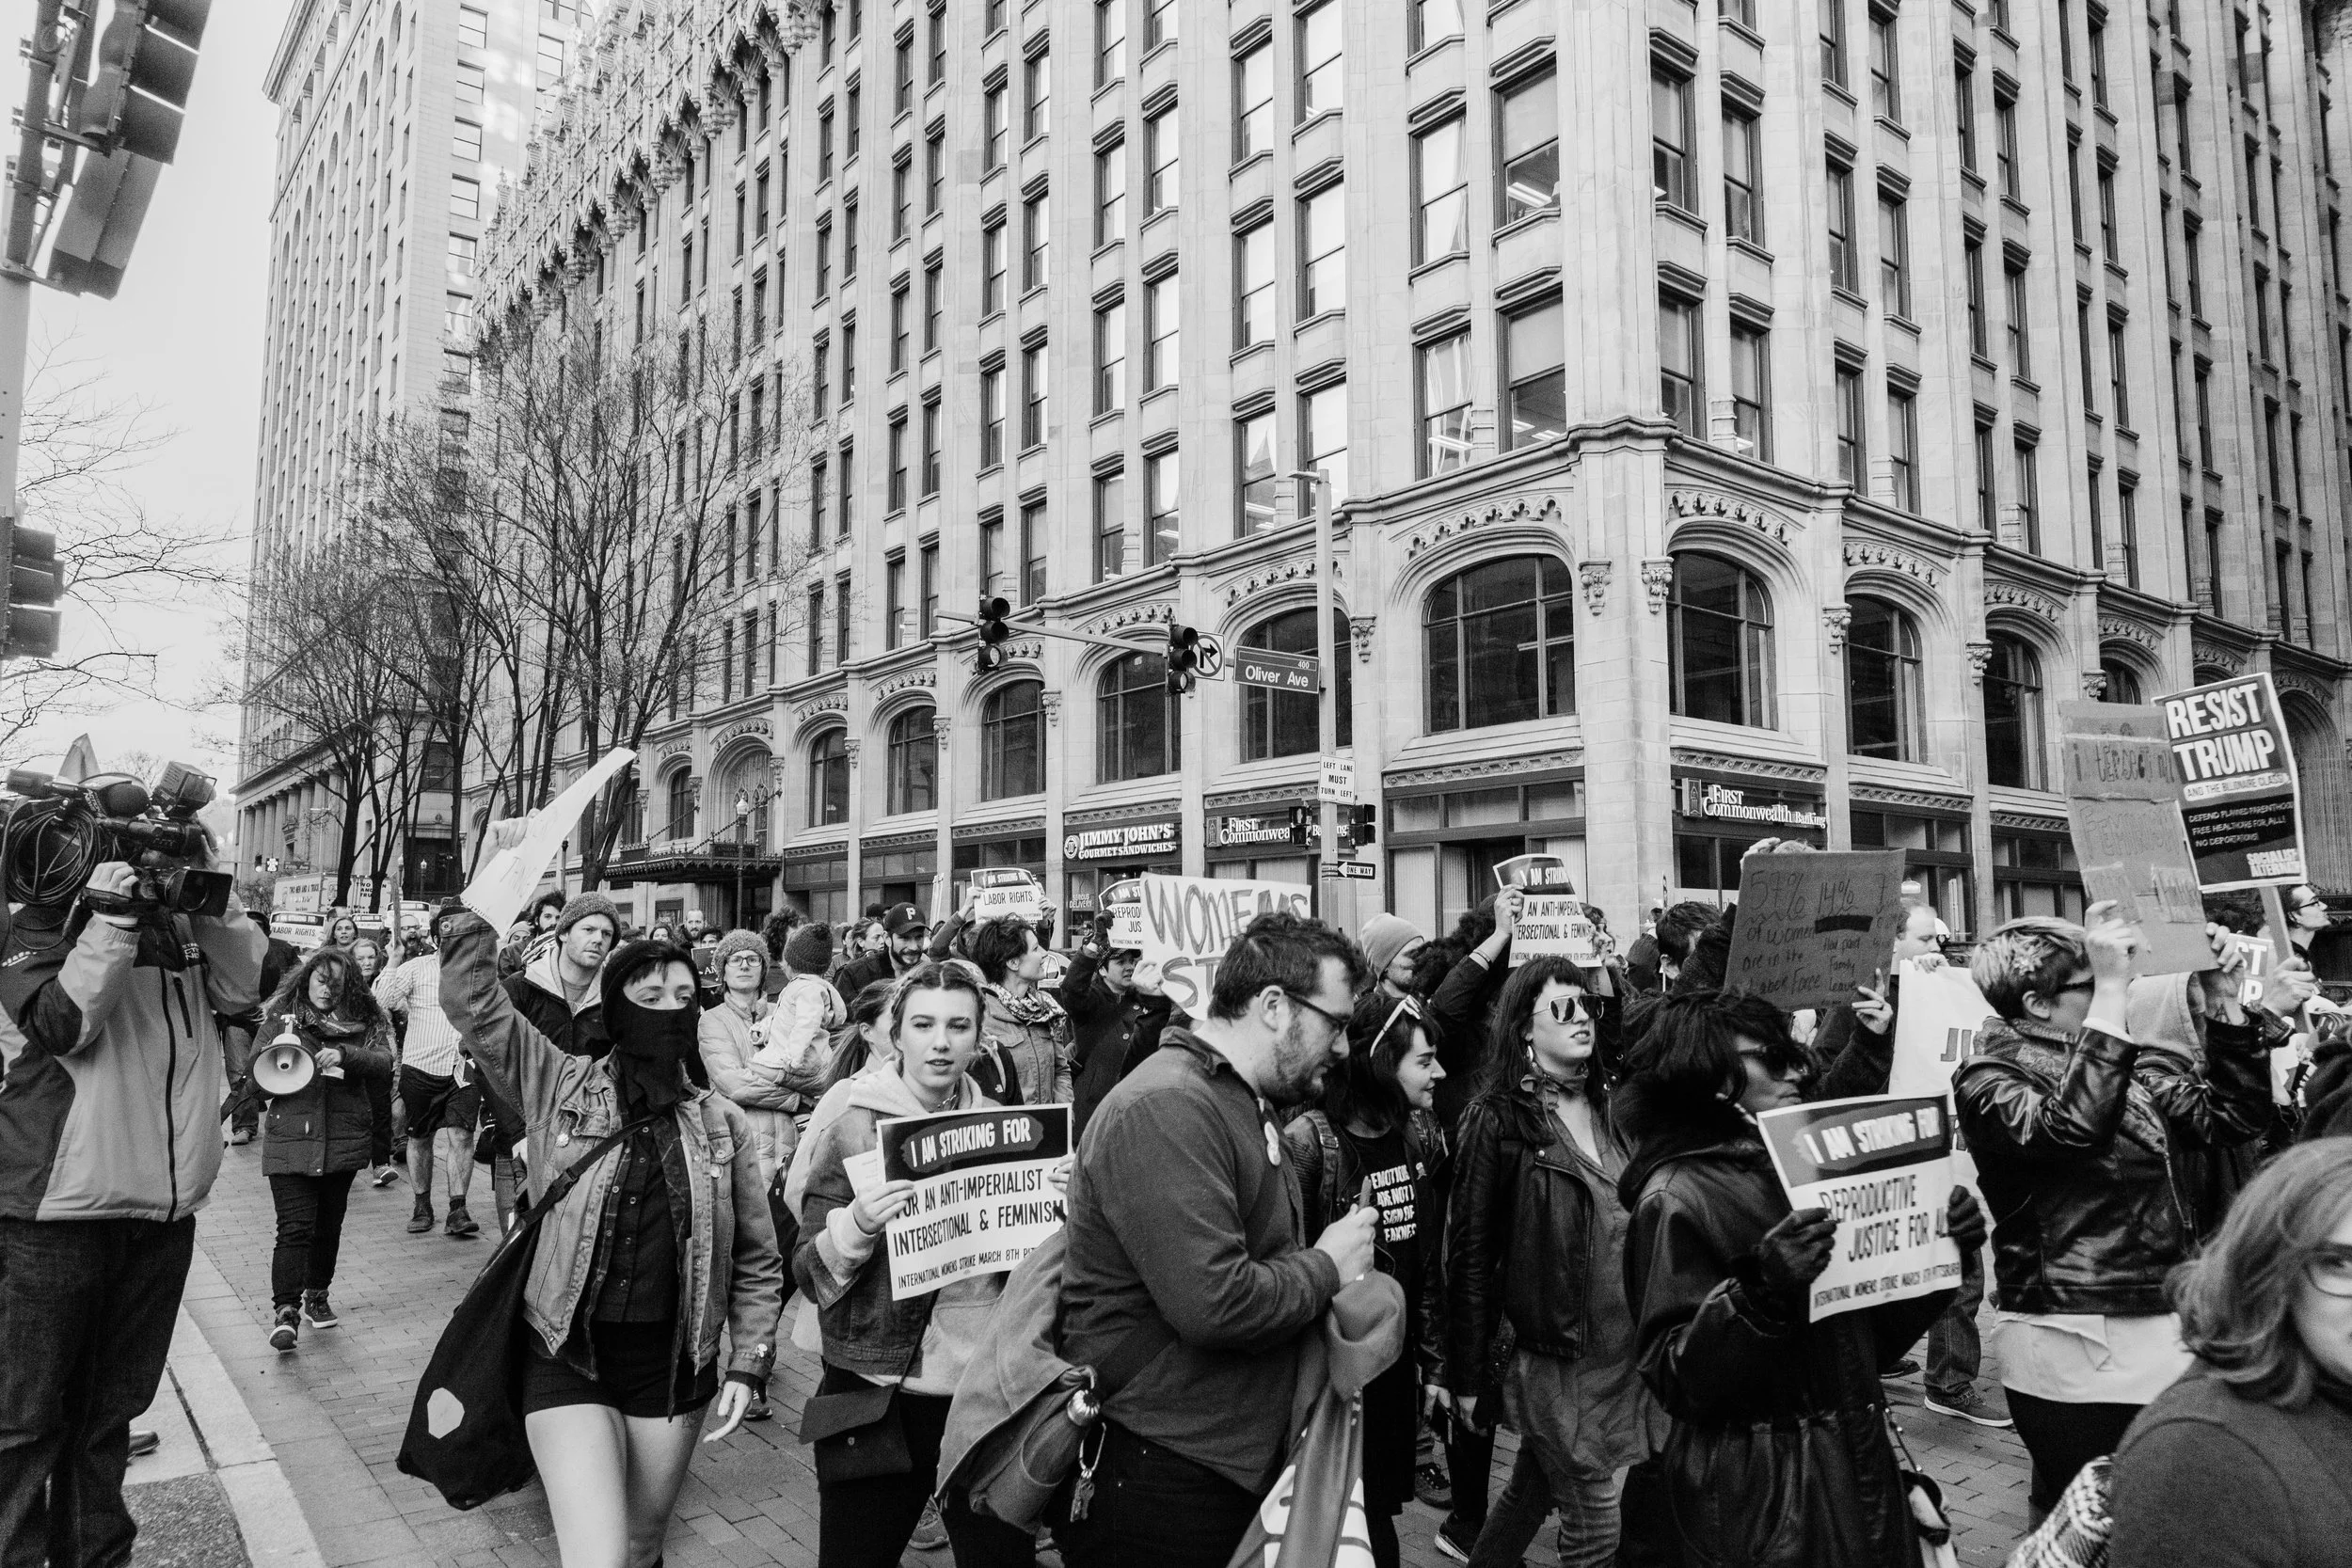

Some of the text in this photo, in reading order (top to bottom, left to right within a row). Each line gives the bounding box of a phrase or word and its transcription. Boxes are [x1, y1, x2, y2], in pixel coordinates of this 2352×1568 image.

[1297, 660, 1310, 669] 400
[1245, 665, 1309, 688] Oliver Ave
[2165, 682, 2262, 739] RESIST
[2171, 729, 2276, 782] TRUMP
[1323, 761, 1354, 772] LEFT LANE
[1328, 774, 1347, 785] MUST
[1321, 786, 1353, 799] TURN LEFT
[1708, 784, 1744, 805] FIRST
[1703, 796, 1826, 829] Commonwealth Banking
[2188, 811, 2220, 823] DEFEND
[1220, 823, 1290, 845] Commonwea
[1229, 817, 1259, 832] FIRST
[1079, 823, 1175, 850] JIMMY JOHN'S
[1078, 842, 1175, 860] GOURMET SANDWICHES
[1346, 865, 1372, 876] ONE WAY
[1519, 870, 1528, 887] I
[1530, 868, 1543, 886] AM
[983, 892, 1007, 906] LABOR
[1751, 870, 1806, 911] 57%
[1818, 878, 1854, 915] 14%
[906, 907, 915, 920] P
[1527, 901, 1538, 917] AN
[274, 927, 292, 935] LABOR
[1128, 920, 1141, 933] JUS
[1516, 924, 1561, 940] TERSECTIONAL
[1564, 923, 1568, 939] &
[1767, 926, 1817, 945] women
[1161, 956, 1225, 1009] ST
[911, 1117, 1032, 1167] I AM STRIKING FOR
[1804, 1133, 1824, 1164] I
[1820, 1125, 1856, 1161] AM
[1851, 1112, 1915, 1153] STRIKING
[925, 1185, 936, 1213] AN
[940, 1168, 1043, 1208] ANTI-IMPERIALIST
[1819, 1174, 1916, 1224] REPRODUCTIVE
[893, 1212, 972, 1258] INTERSECTIONAL
[979, 1209, 989, 1231] &
[1848, 1207, 1949, 1262] JUSTICE FOR AL
[898, 1268, 941, 1290] INTERNATIONAL
[941, 1258, 958, 1275] WOMENS
[959, 1254, 977, 1271] STRIKE
[978, 1247, 1002, 1264] MARCH
[1005, 1245, 1020, 1261] 8TH
